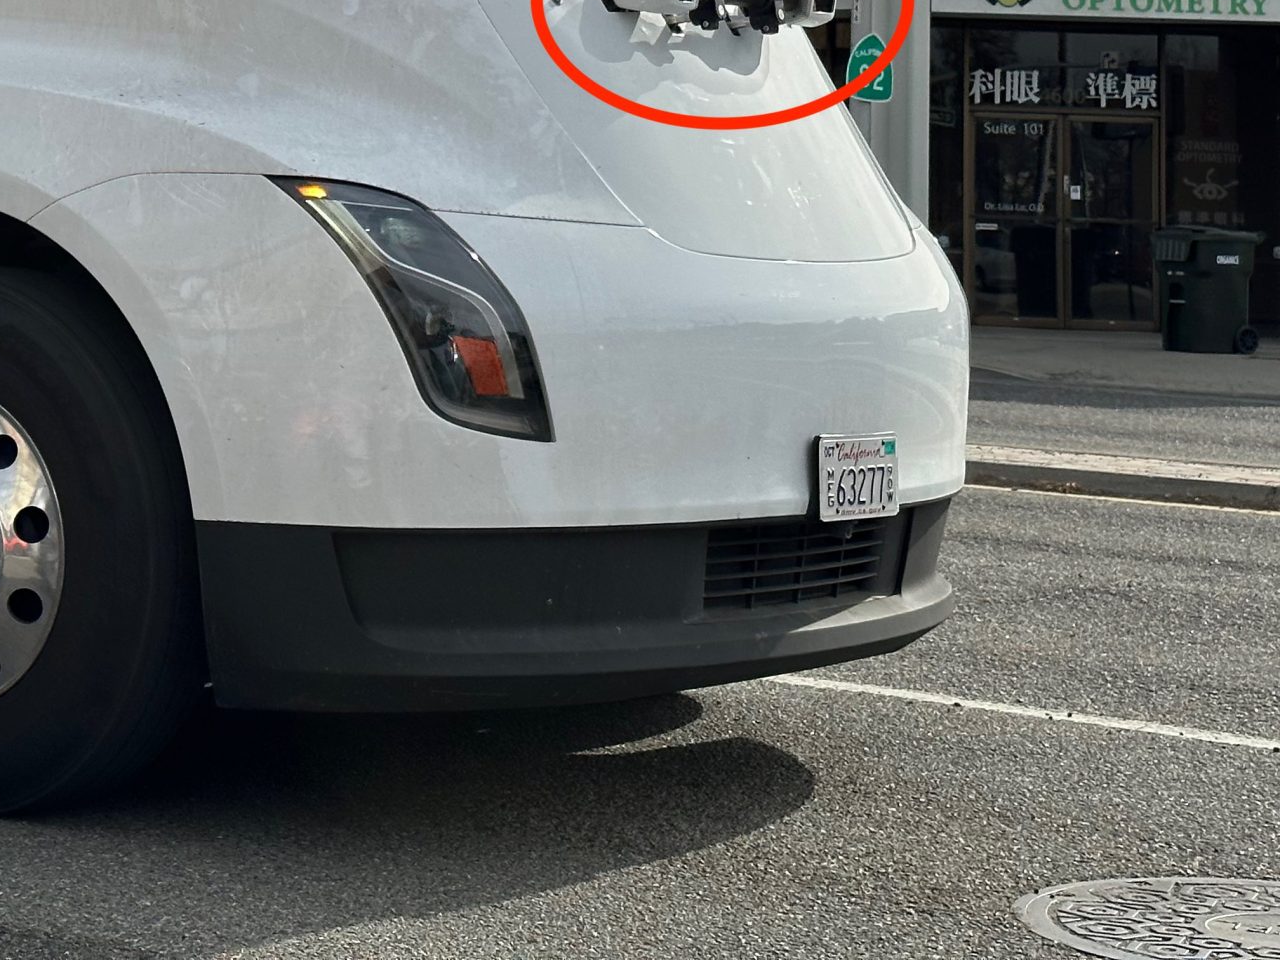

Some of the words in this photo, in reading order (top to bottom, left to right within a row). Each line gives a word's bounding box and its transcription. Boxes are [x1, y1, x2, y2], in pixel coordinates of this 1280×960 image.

[983, 122, 1017, 135] Suite
[1024, 123, 1045, 136] 101
[837, 464, 885, 506] 63277
